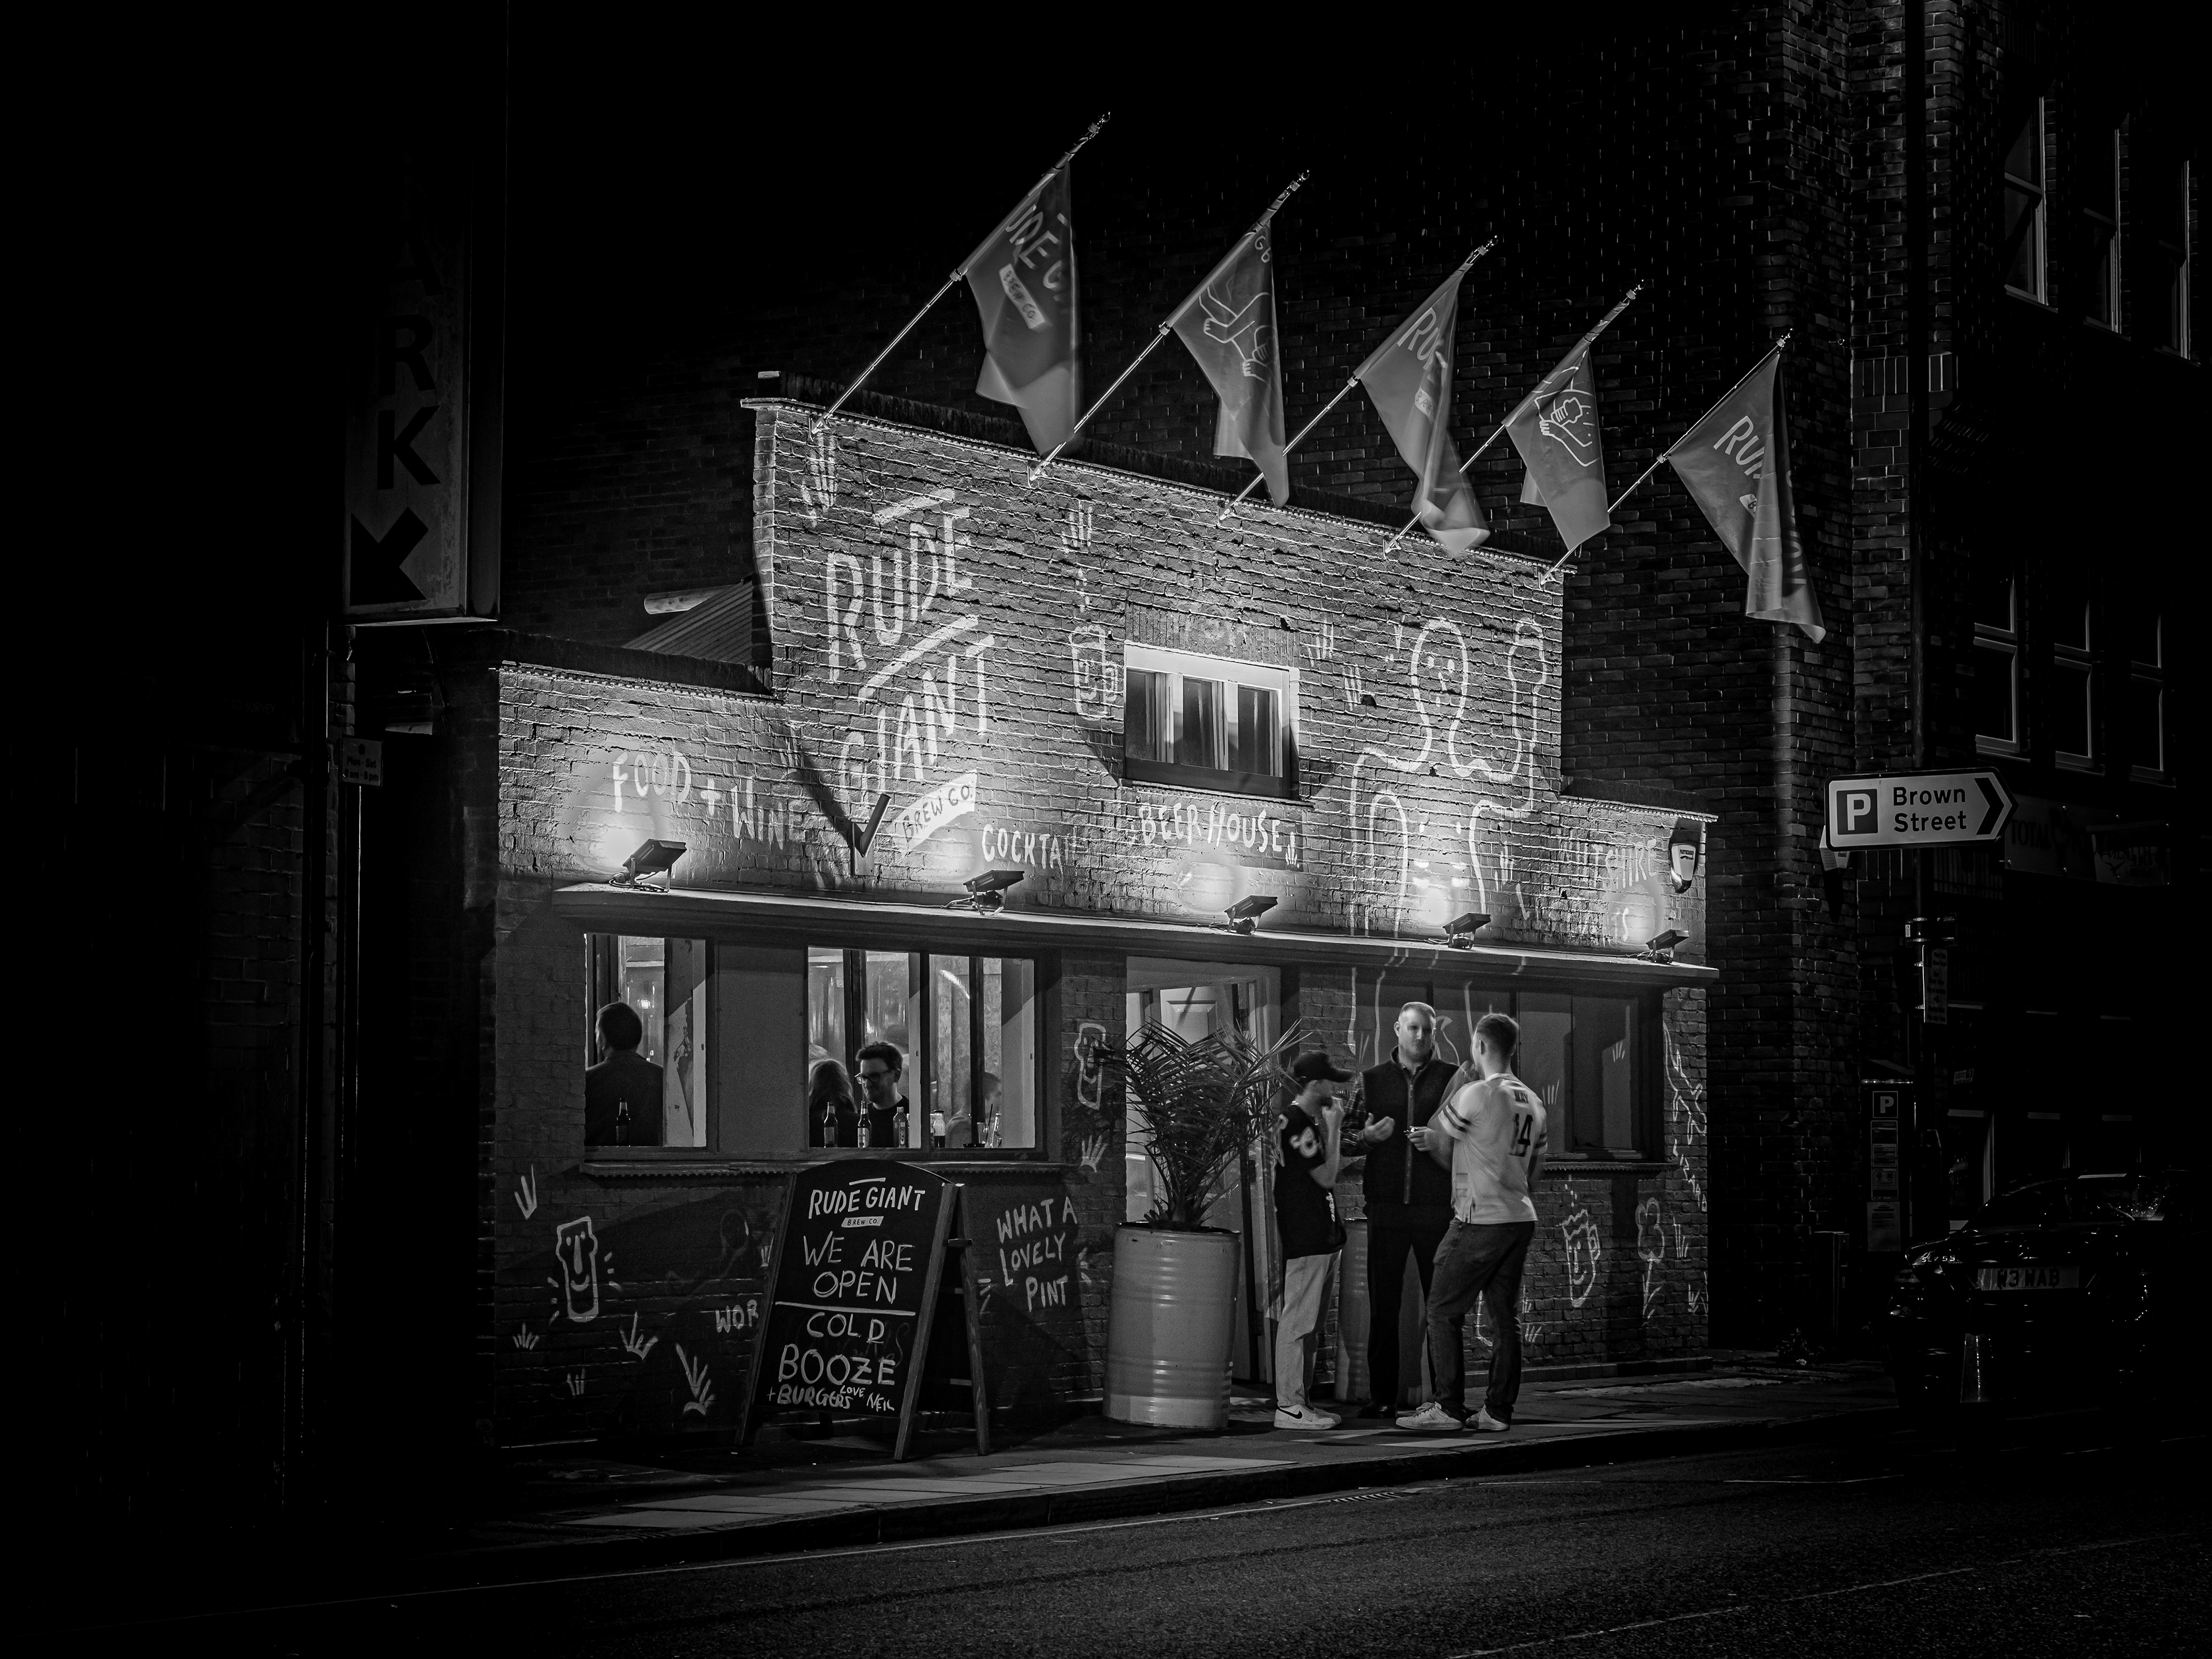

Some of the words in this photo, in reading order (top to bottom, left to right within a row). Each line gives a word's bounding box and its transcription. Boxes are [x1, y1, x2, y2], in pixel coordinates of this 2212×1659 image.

[376, 224, 444, 490] ARK
[826, 507, 974, 683] RUDE
[839, 634, 995, 821] GIANT
[612, 751, 692, 813] FOOD
[730, 776, 806, 850] WINE
[1847, 793, 1871, 831] P
[1893, 786, 1966, 806] Brown
[902, 796, 944, 843] BREW
[1139, 802, 1202, 845] BEER
[1207, 805, 1283, 853] HOUSE
[1893, 810, 1967, 832] Street
[1880, 1096, 1895, 1113] P
[808, 1189, 861, 1219] RUDE
[865, 1185, 926, 1211] GIANT
[997, 1198, 1054, 1244] WHAT
[1062, 1196, 1078, 1224] A
[803, 1230, 844, 1267] WE
[861, 1238, 915, 1272] ARE
[999, 1232, 1066, 1287] LOVELY
[812, 1270, 897, 1304] OPEN
[1025, 1275, 1069, 1312] PINT
[806, 1311, 885, 1344] COLD
[778, 1343, 896, 1385] BOOZE
[777, 1383, 854, 1409] BURGERS
[839, 1385, 866, 1398] LOVE
[866, 1392, 895, 1412] NEIL
